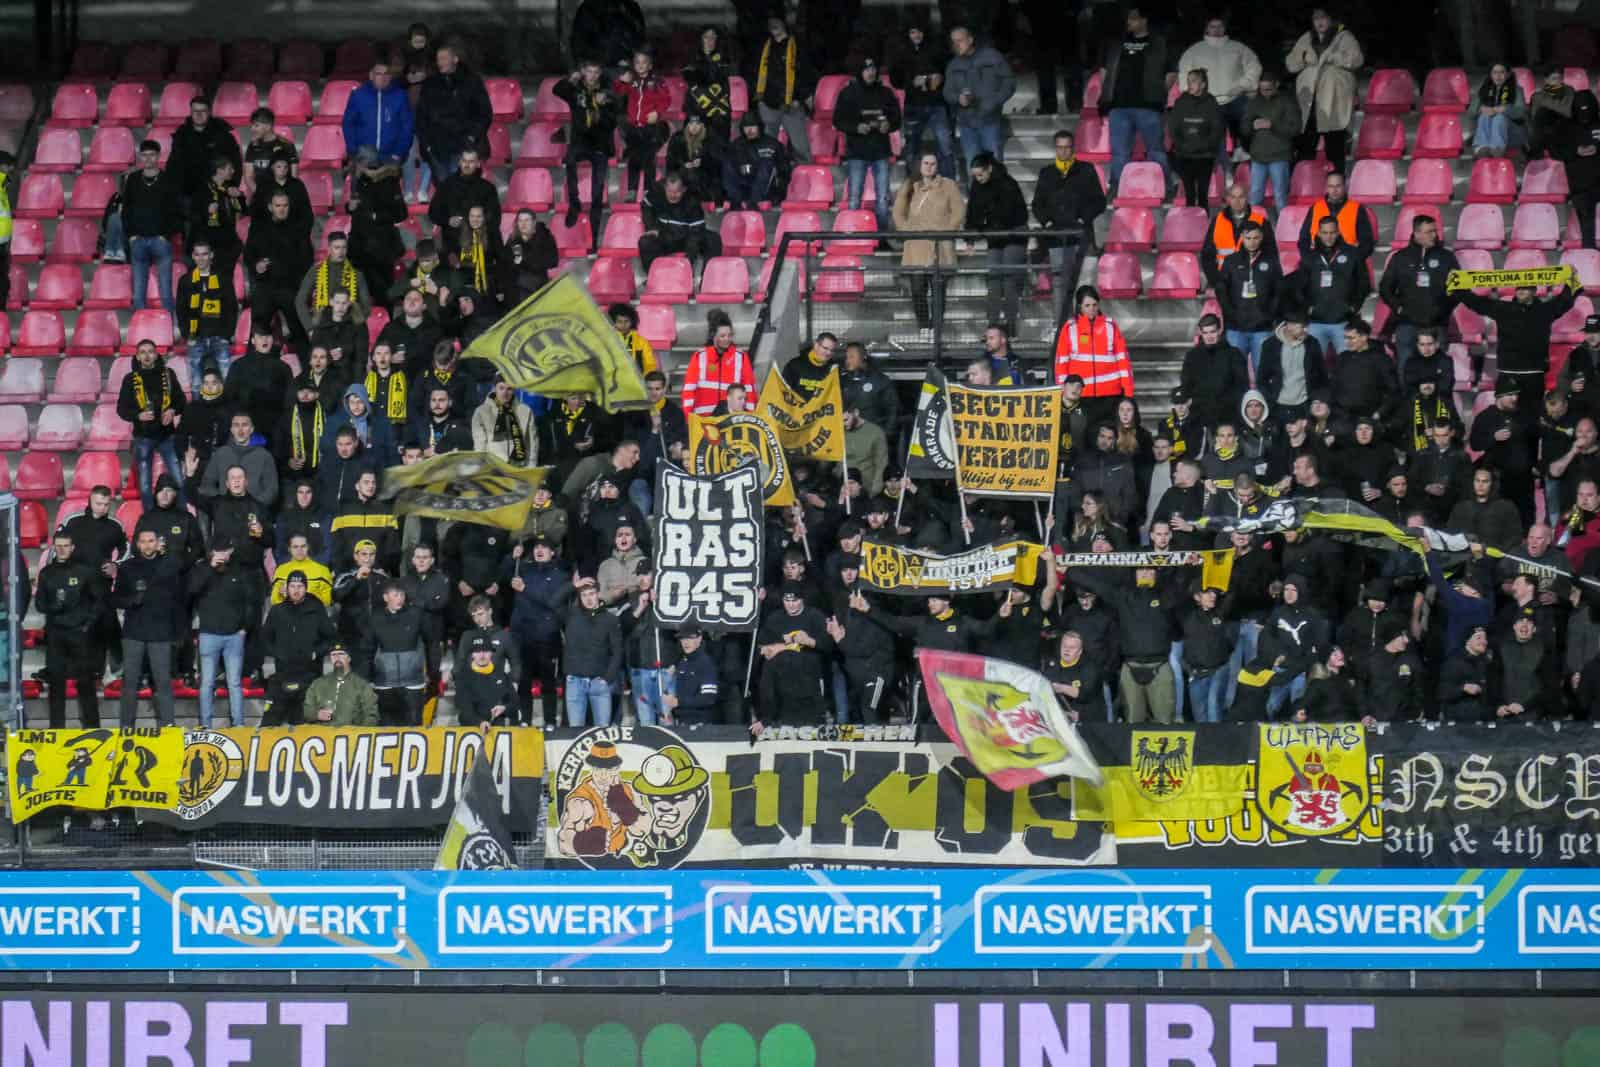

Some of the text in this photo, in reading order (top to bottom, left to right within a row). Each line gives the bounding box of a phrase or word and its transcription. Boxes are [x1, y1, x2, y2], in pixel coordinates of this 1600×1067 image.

[1472, 274, 1521, 283] FORTUNA
[1537, 271, 1559, 280] KUT
[950, 392, 1053, 418] SECTIE
[667, 473, 753, 520] ULT
[662, 522, 754, 567] RAS
[658, 571, 754, 618] 045
[1266, 724, 1361, 752] ULTRAS
[558, 725, 634, 791] KERKRADE
[119, 788, 168, 804] TOUR
[1383, 823, 1434, 859] 3th
[1448, 823, 1479, 855] &
[1492, 824, 1544, 859] 4th
